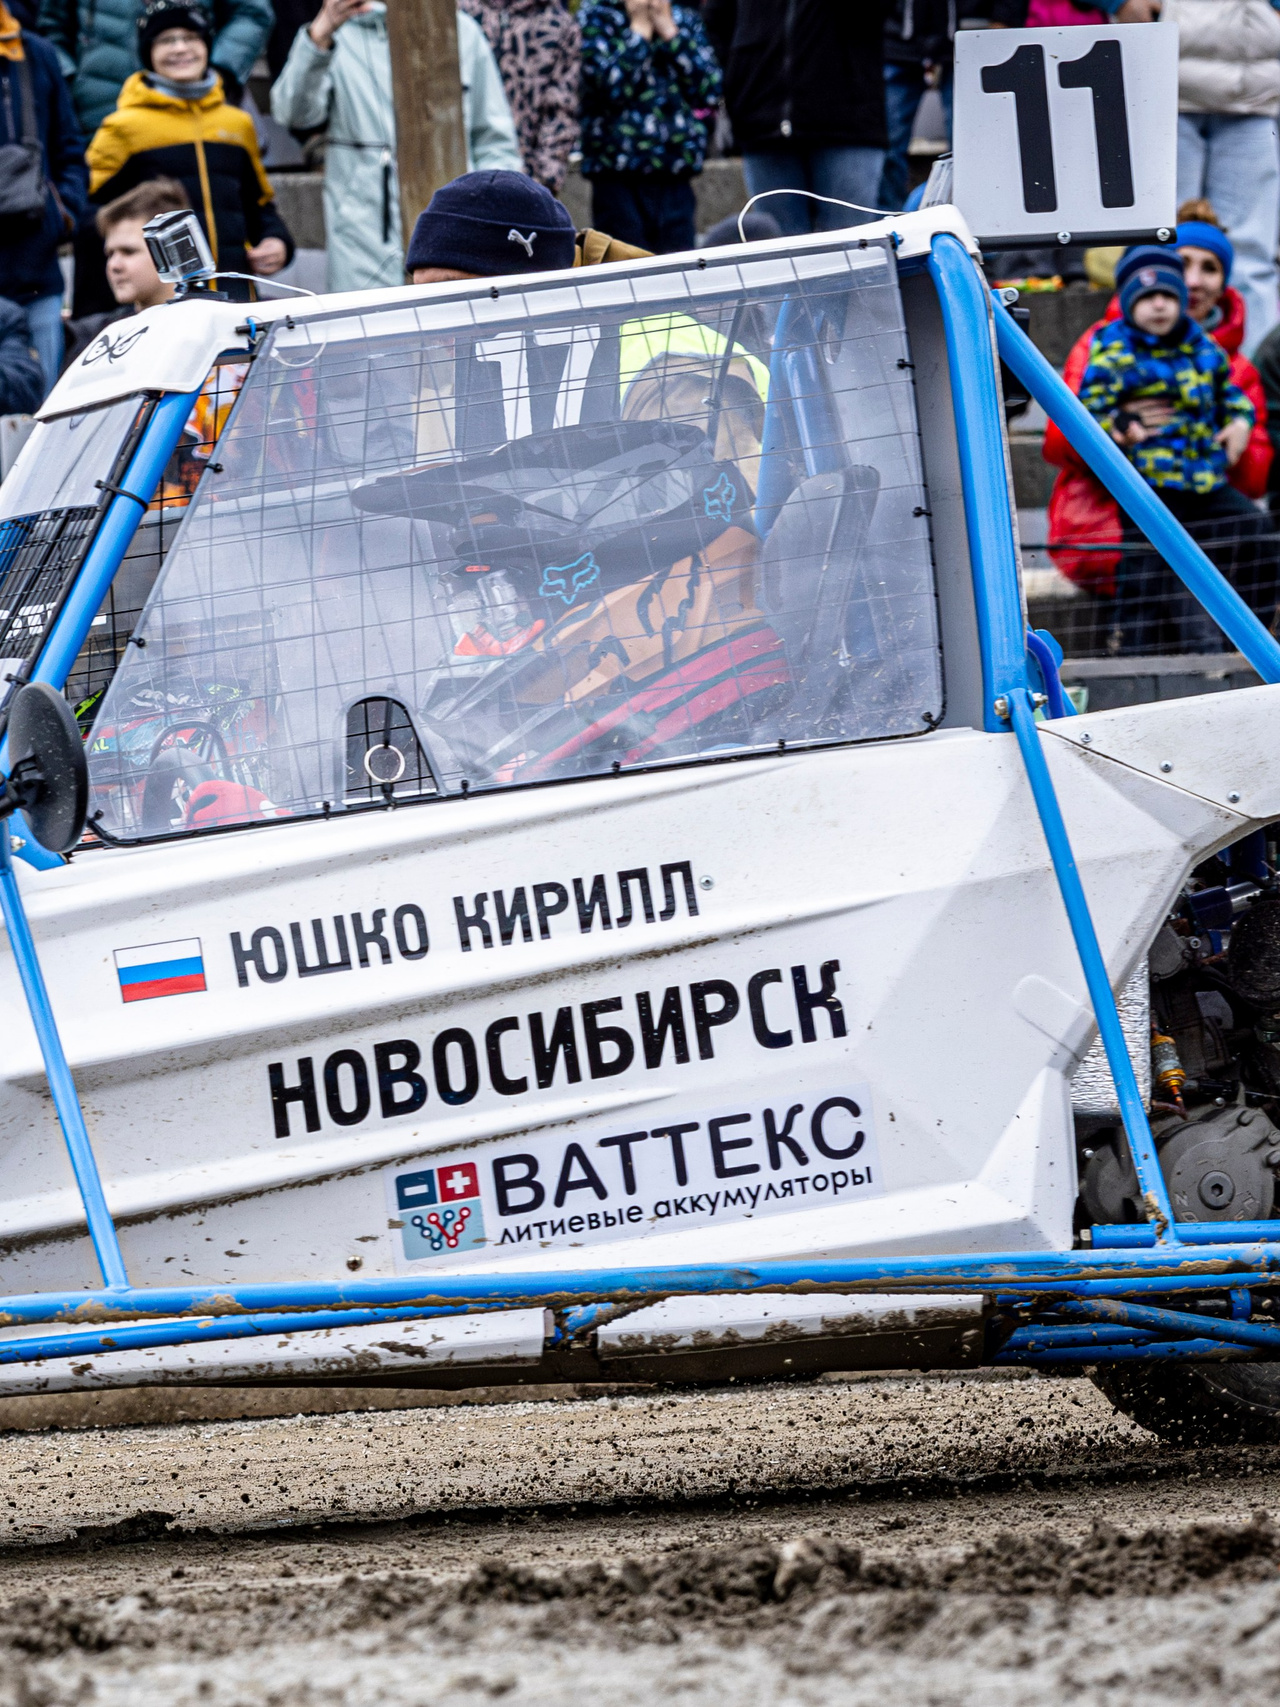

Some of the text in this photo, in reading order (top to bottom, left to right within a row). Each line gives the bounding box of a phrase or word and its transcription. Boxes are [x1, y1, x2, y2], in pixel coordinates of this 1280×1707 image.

[980, 38, 1135, 214] 11
[475, 323, 601, 441] 17
[229, 860, 700, 988] ЮШКО КИРИЛЛ
[267, 958, 848, 1139] НОВОСИБИРСК
[491, 1096, 867, 1217] ВАТТЕКС
[498, 1164, 875, 1245] литиевые аккумуляторы
